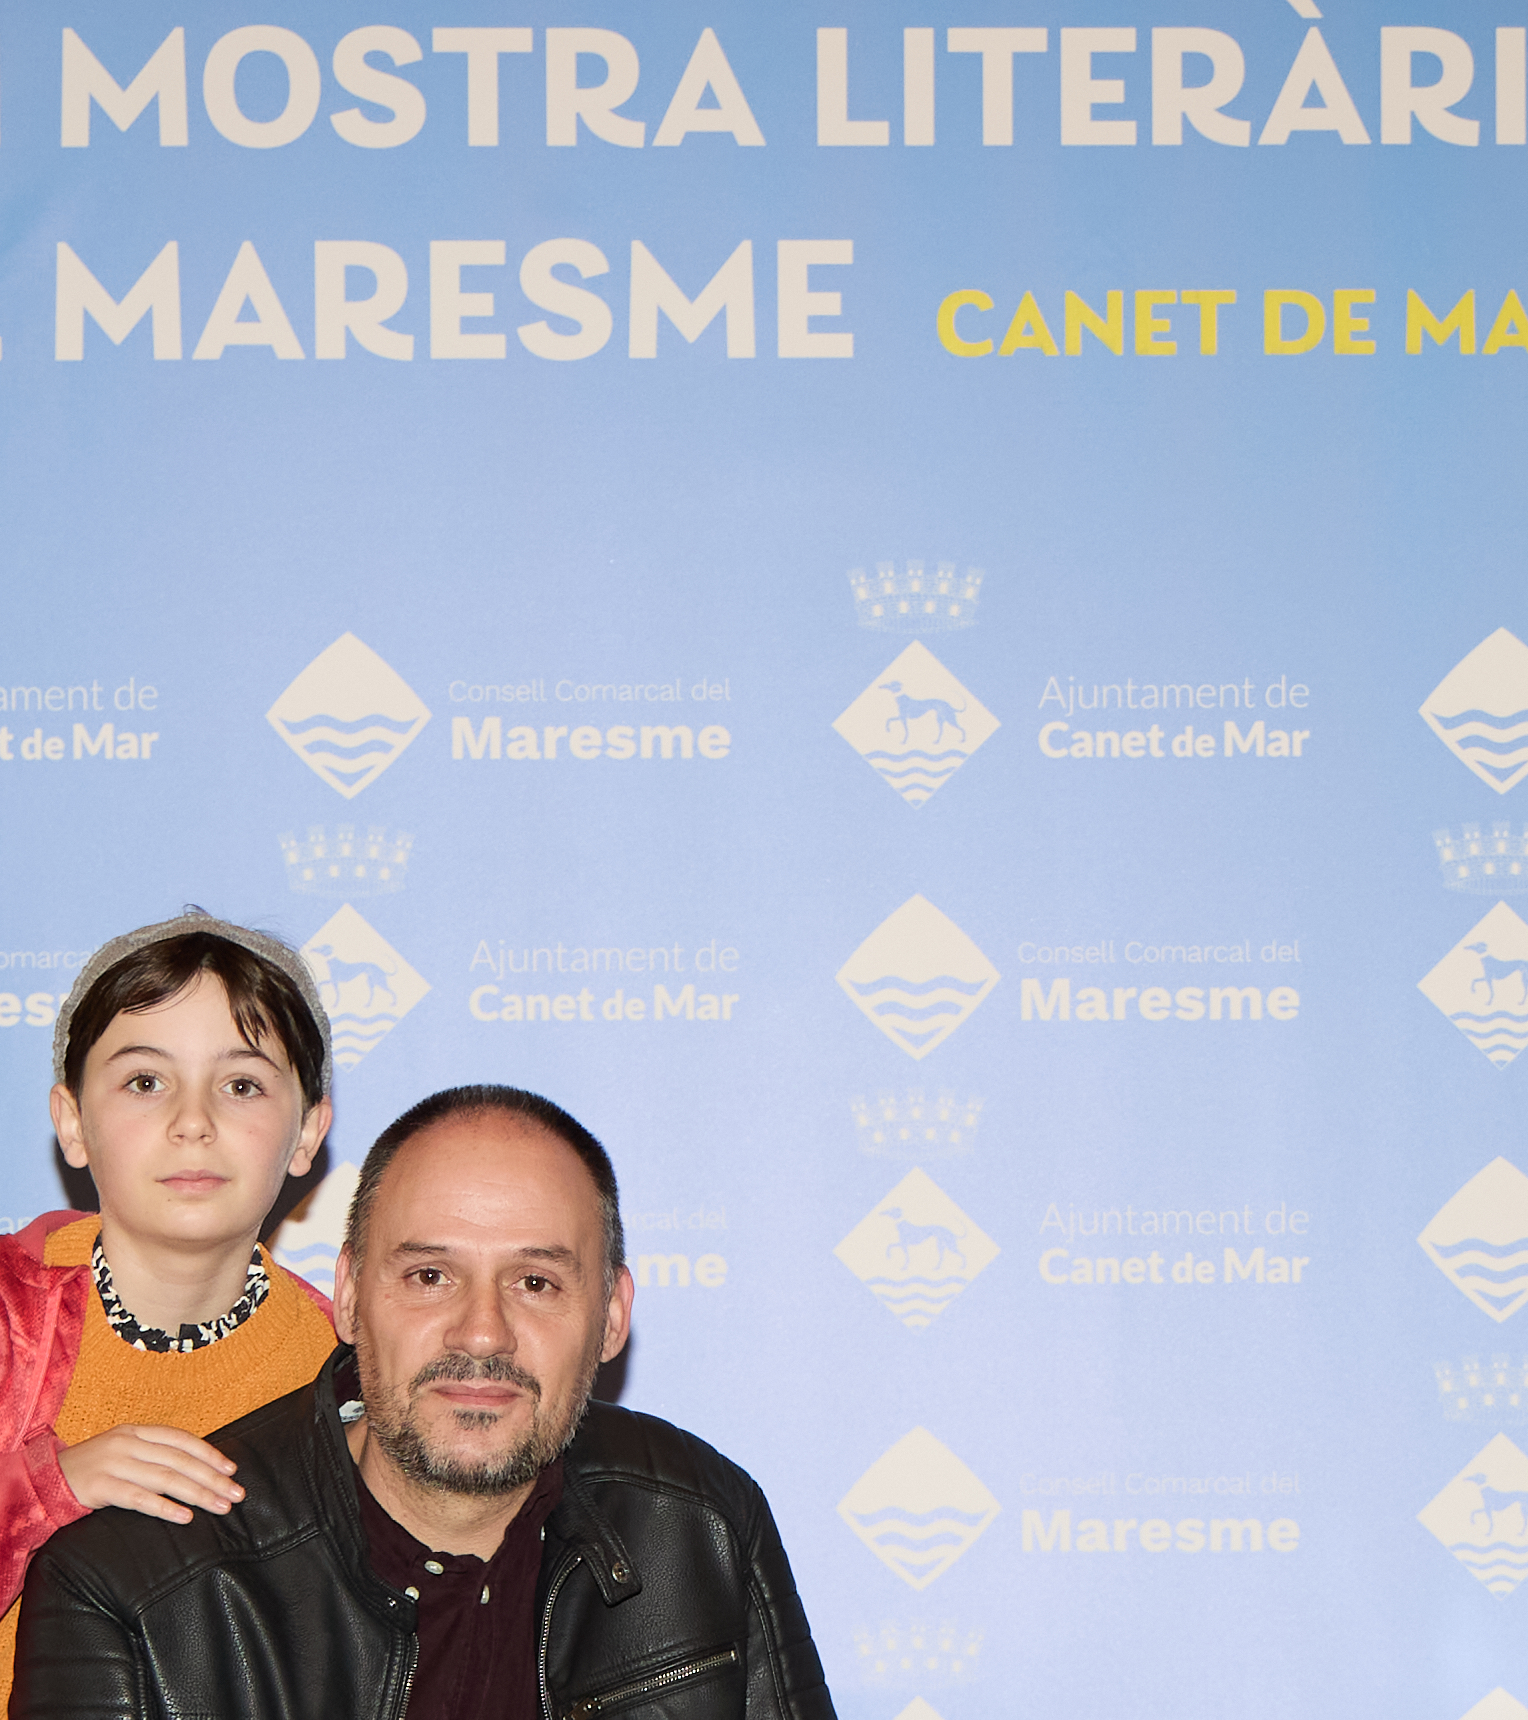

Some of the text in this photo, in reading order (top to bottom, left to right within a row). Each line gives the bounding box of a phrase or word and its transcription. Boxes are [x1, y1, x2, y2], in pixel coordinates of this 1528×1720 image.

[61, 24, 766, 149] MOSTRA
[55, 237, 854, 361] MARESME
[935, 288, 1238, 359] CANET
[1262, 287, 1377, 356] DE
[113, 676, 159, 711] de
[448, 677, 732, 703] Consell Comarcal del
[1038, 674, 1310, 717] Ajuntament de
[20, 727, 66, 761] de
[72, 722, 159, 760] Mar
[451, 715, 732, 760] Maresme
[1038, 720, 1311, 759] Canet de Mar
[468, 938, 740, 981] Ajuntament de
[1017, 939, 1301, 965] Consell Comarcal del
[468, 983, 740, 1022] Canet de Mar
[1020, 977, 1301, 1022] Maresme
[1038, 1201, 1310, 1243] Ajuntament de
[1038, 1246, 1311, 1285] Canet de Mar
[1021, 1509, 1301, 1553] Maresme
